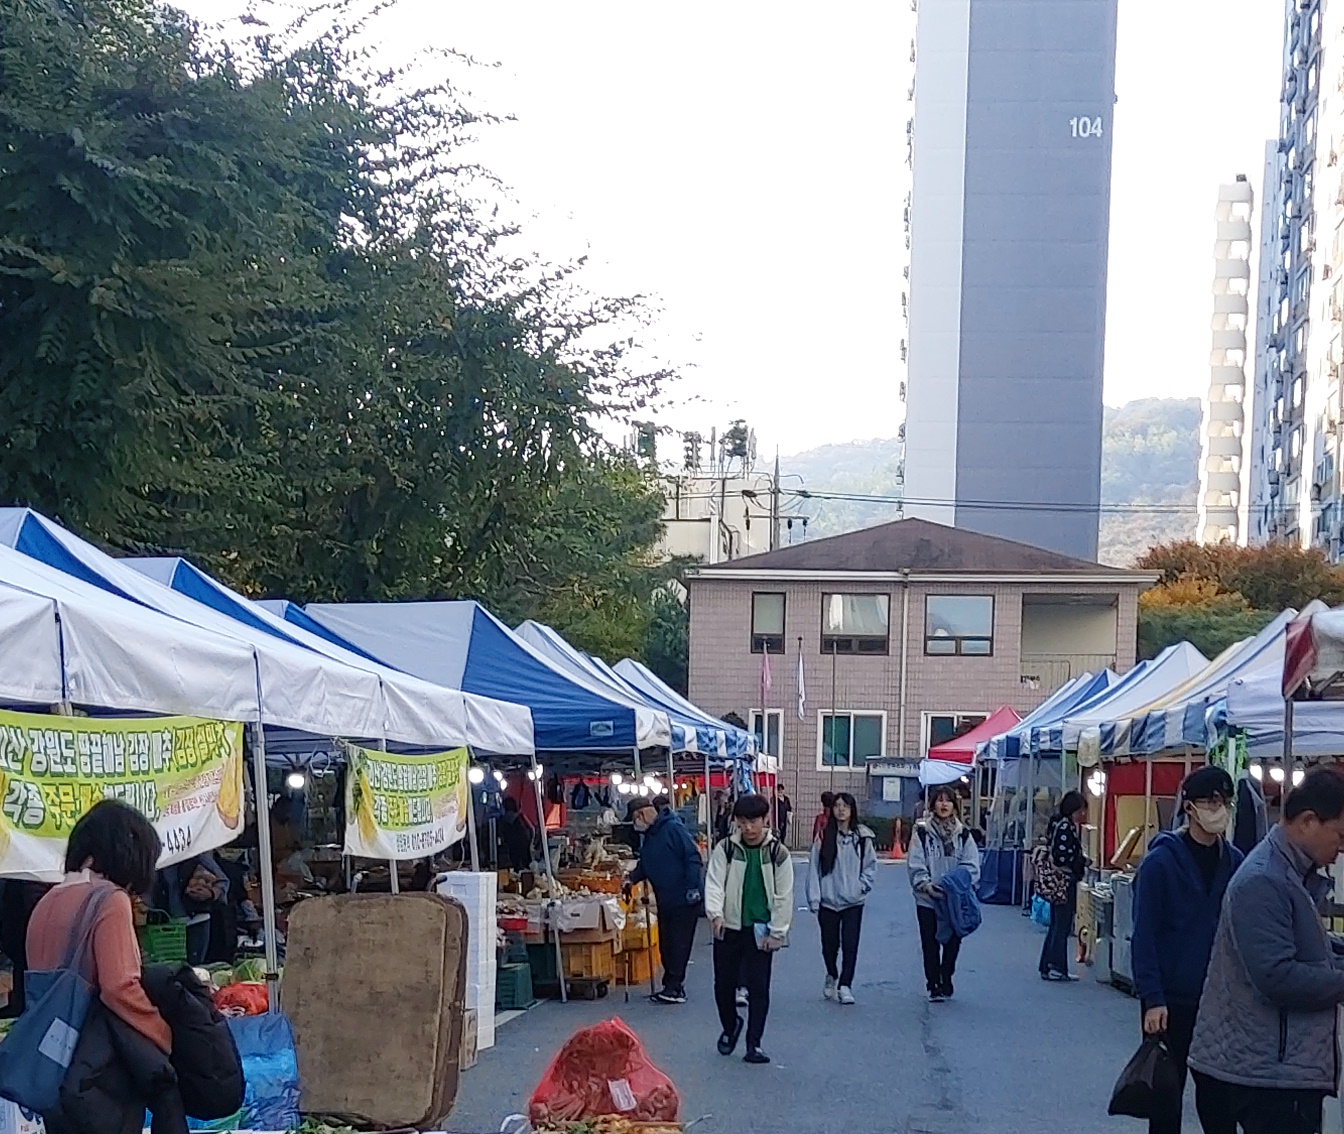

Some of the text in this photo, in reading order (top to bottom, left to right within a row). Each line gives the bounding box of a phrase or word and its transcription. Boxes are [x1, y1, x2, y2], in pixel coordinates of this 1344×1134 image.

[1069, 116, 1103, 138] 104
[28, 729, 78, 777] 강원도
[127, 732, 150, 776] 김장
[3, 779, 45, 829] 각종
[42, 783, 77, 829] 주문
